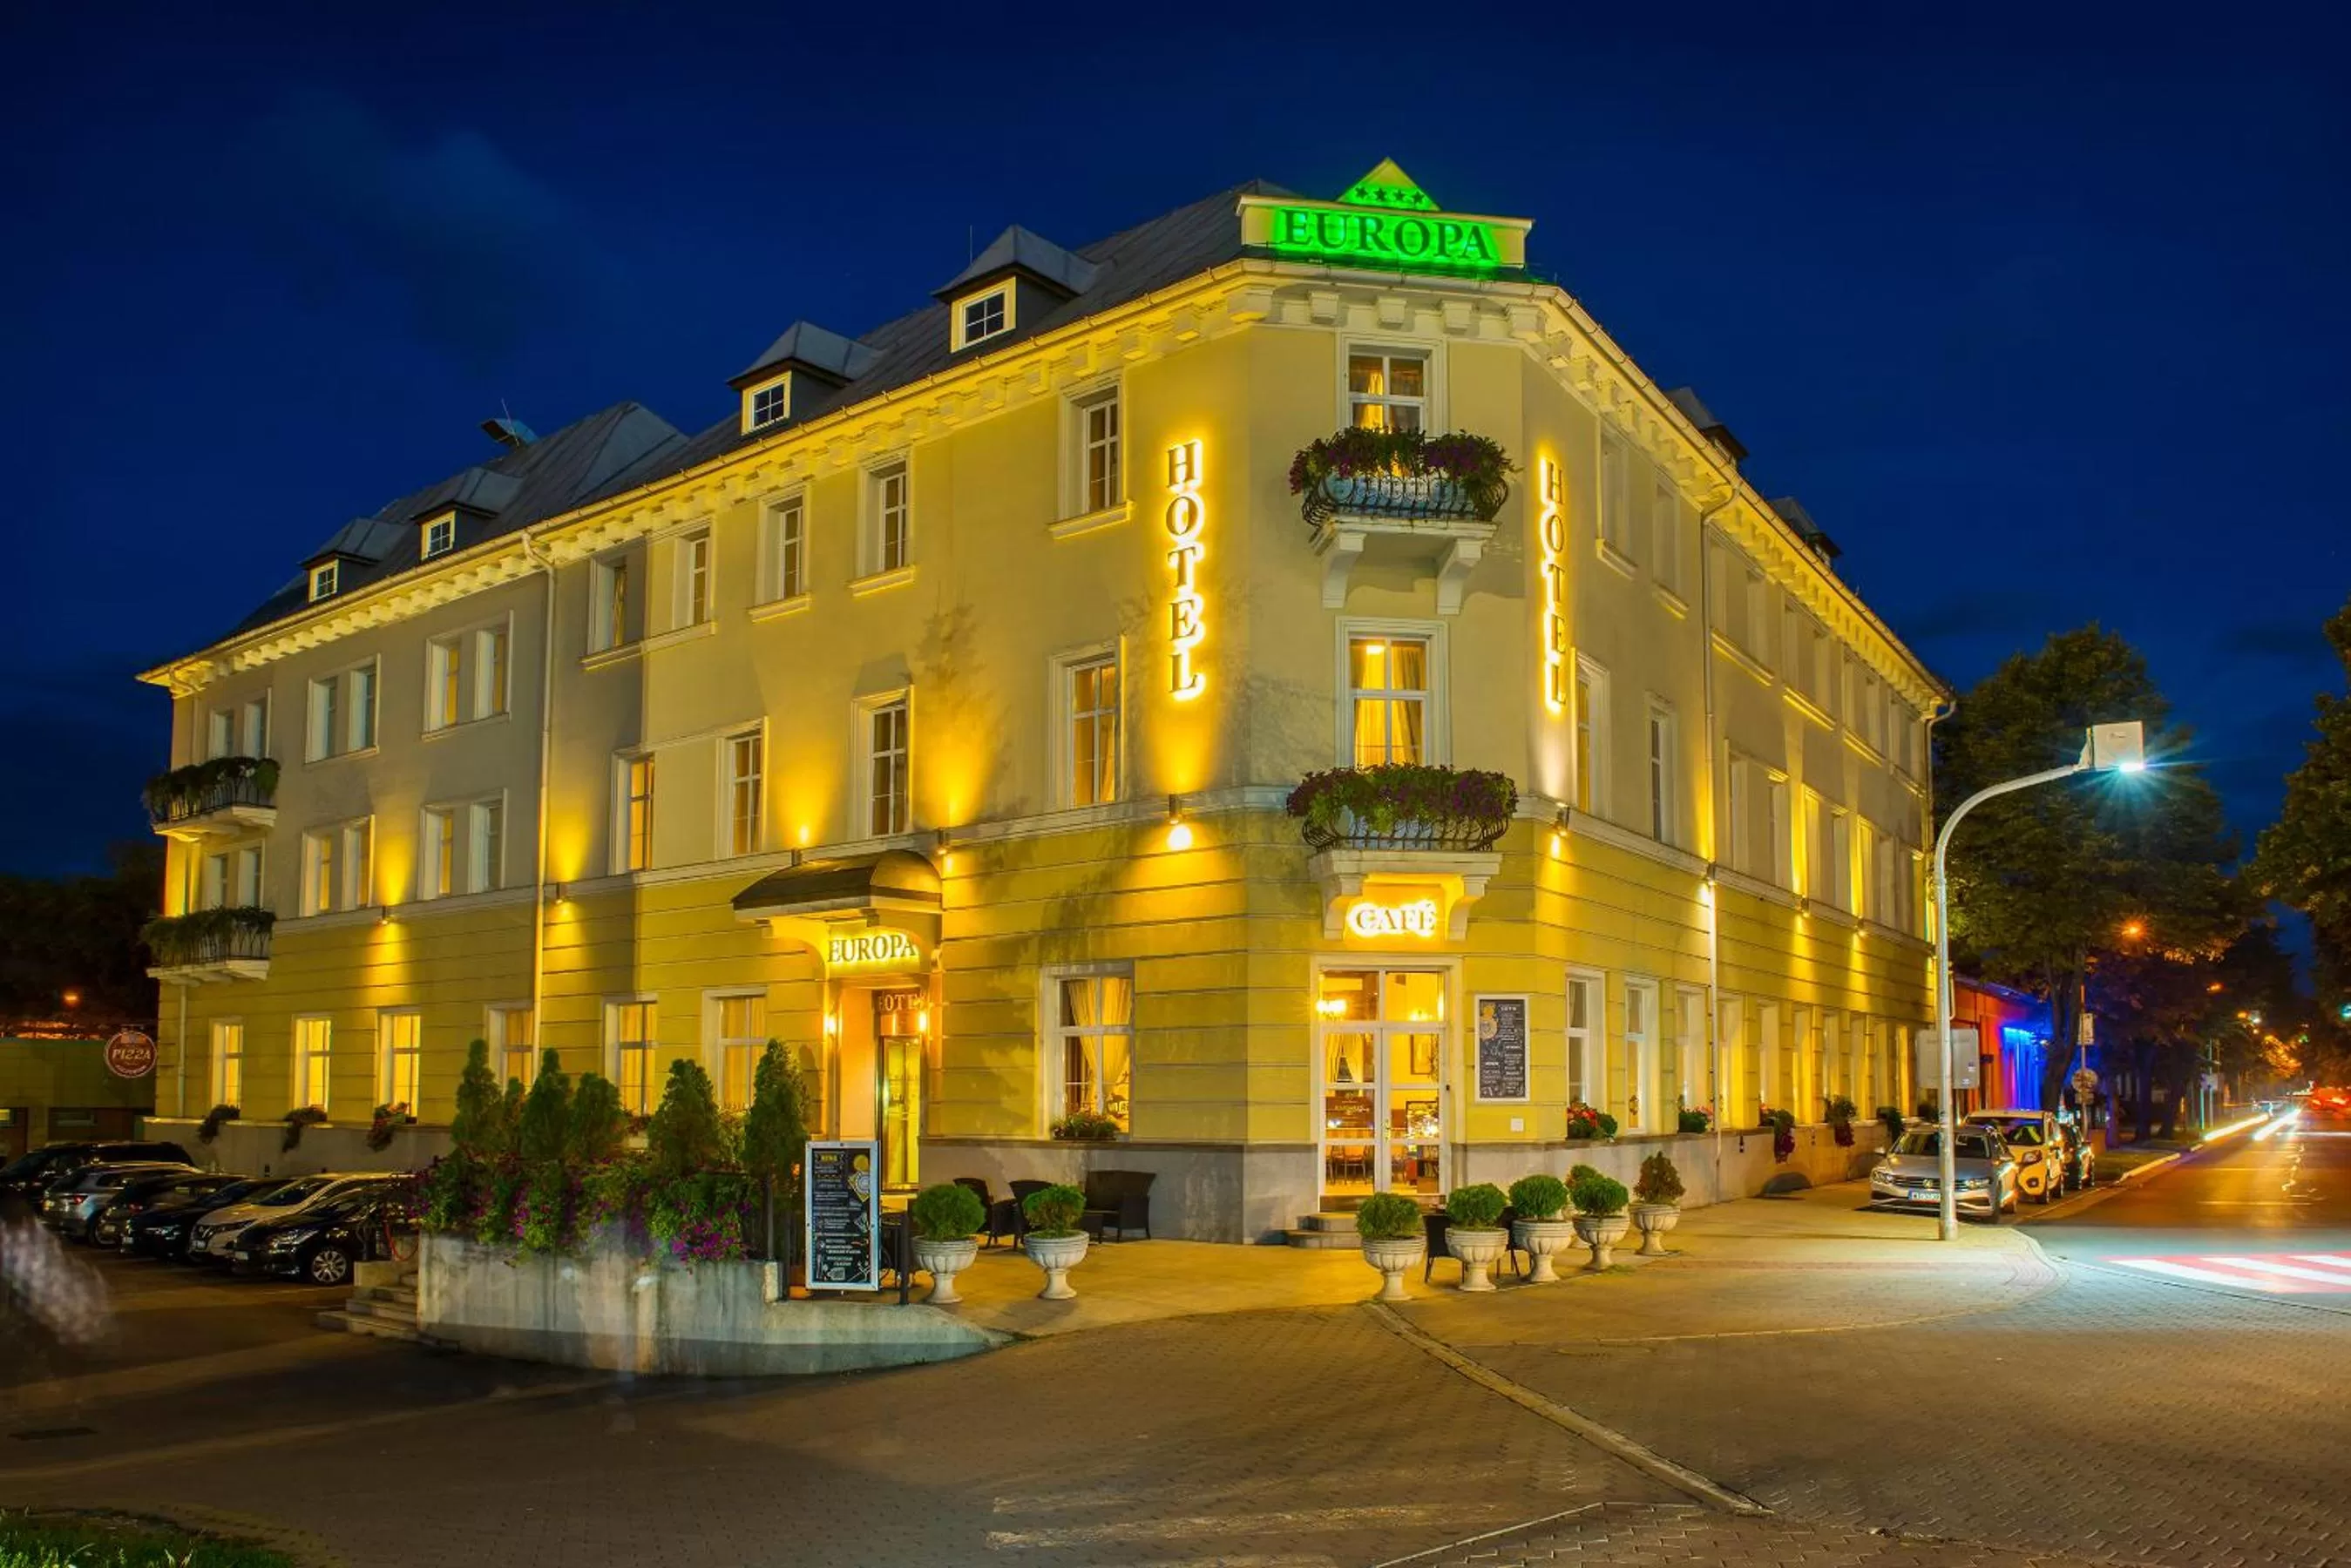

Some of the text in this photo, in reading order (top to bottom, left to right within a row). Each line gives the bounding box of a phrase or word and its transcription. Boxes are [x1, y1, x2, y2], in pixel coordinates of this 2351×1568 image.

[1282, 208, 1493, 260] EUROPA
[1165, 440, 1199, 694] HOTEL
[1546, 461, 1567, 706] HOTEL
[1355, 902, 1437, 931] CAFÉ
[827, 933, 918, 963] EUROPA
[112, 1048, 152, 1060] PIZZA
